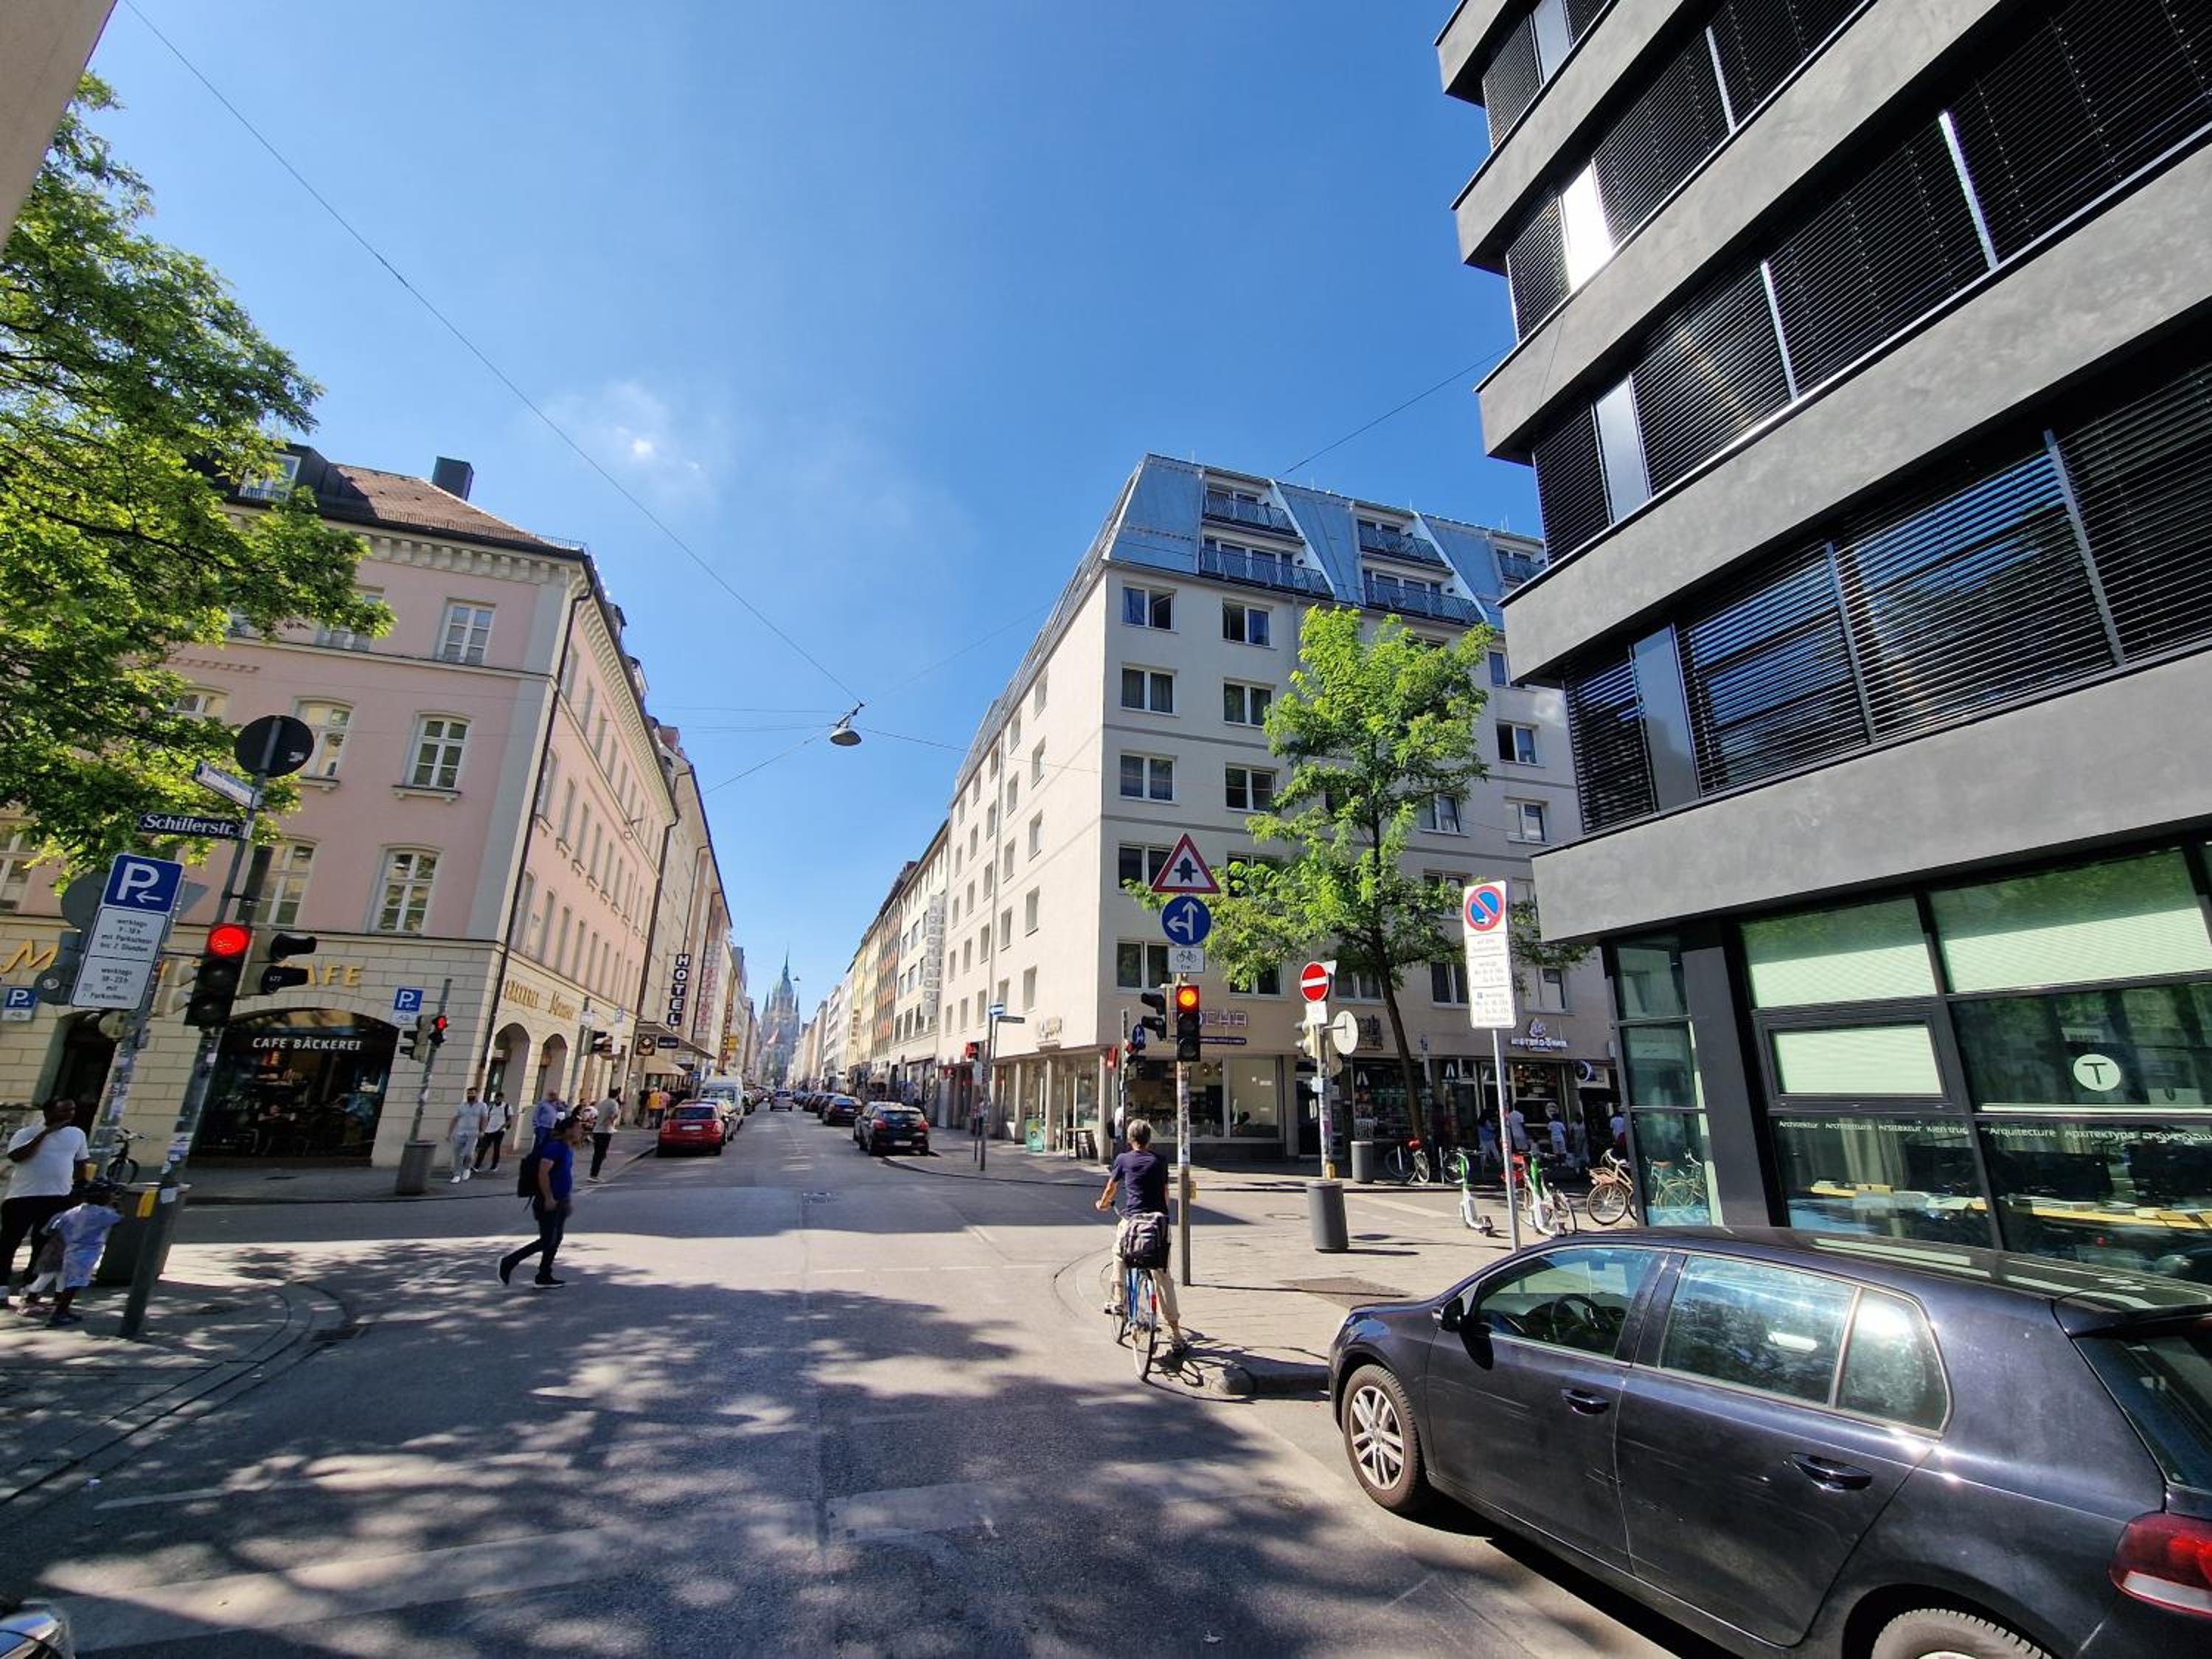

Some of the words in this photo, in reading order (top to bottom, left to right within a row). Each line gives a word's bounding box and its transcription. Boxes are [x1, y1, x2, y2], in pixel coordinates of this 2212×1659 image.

[143, 813, 234, 835] Schillerstr.
[116, 862, 160, 901] P
[667, 953, 690, 1026] HOTEL
[252, 1037, 288, 1048] CAFE
